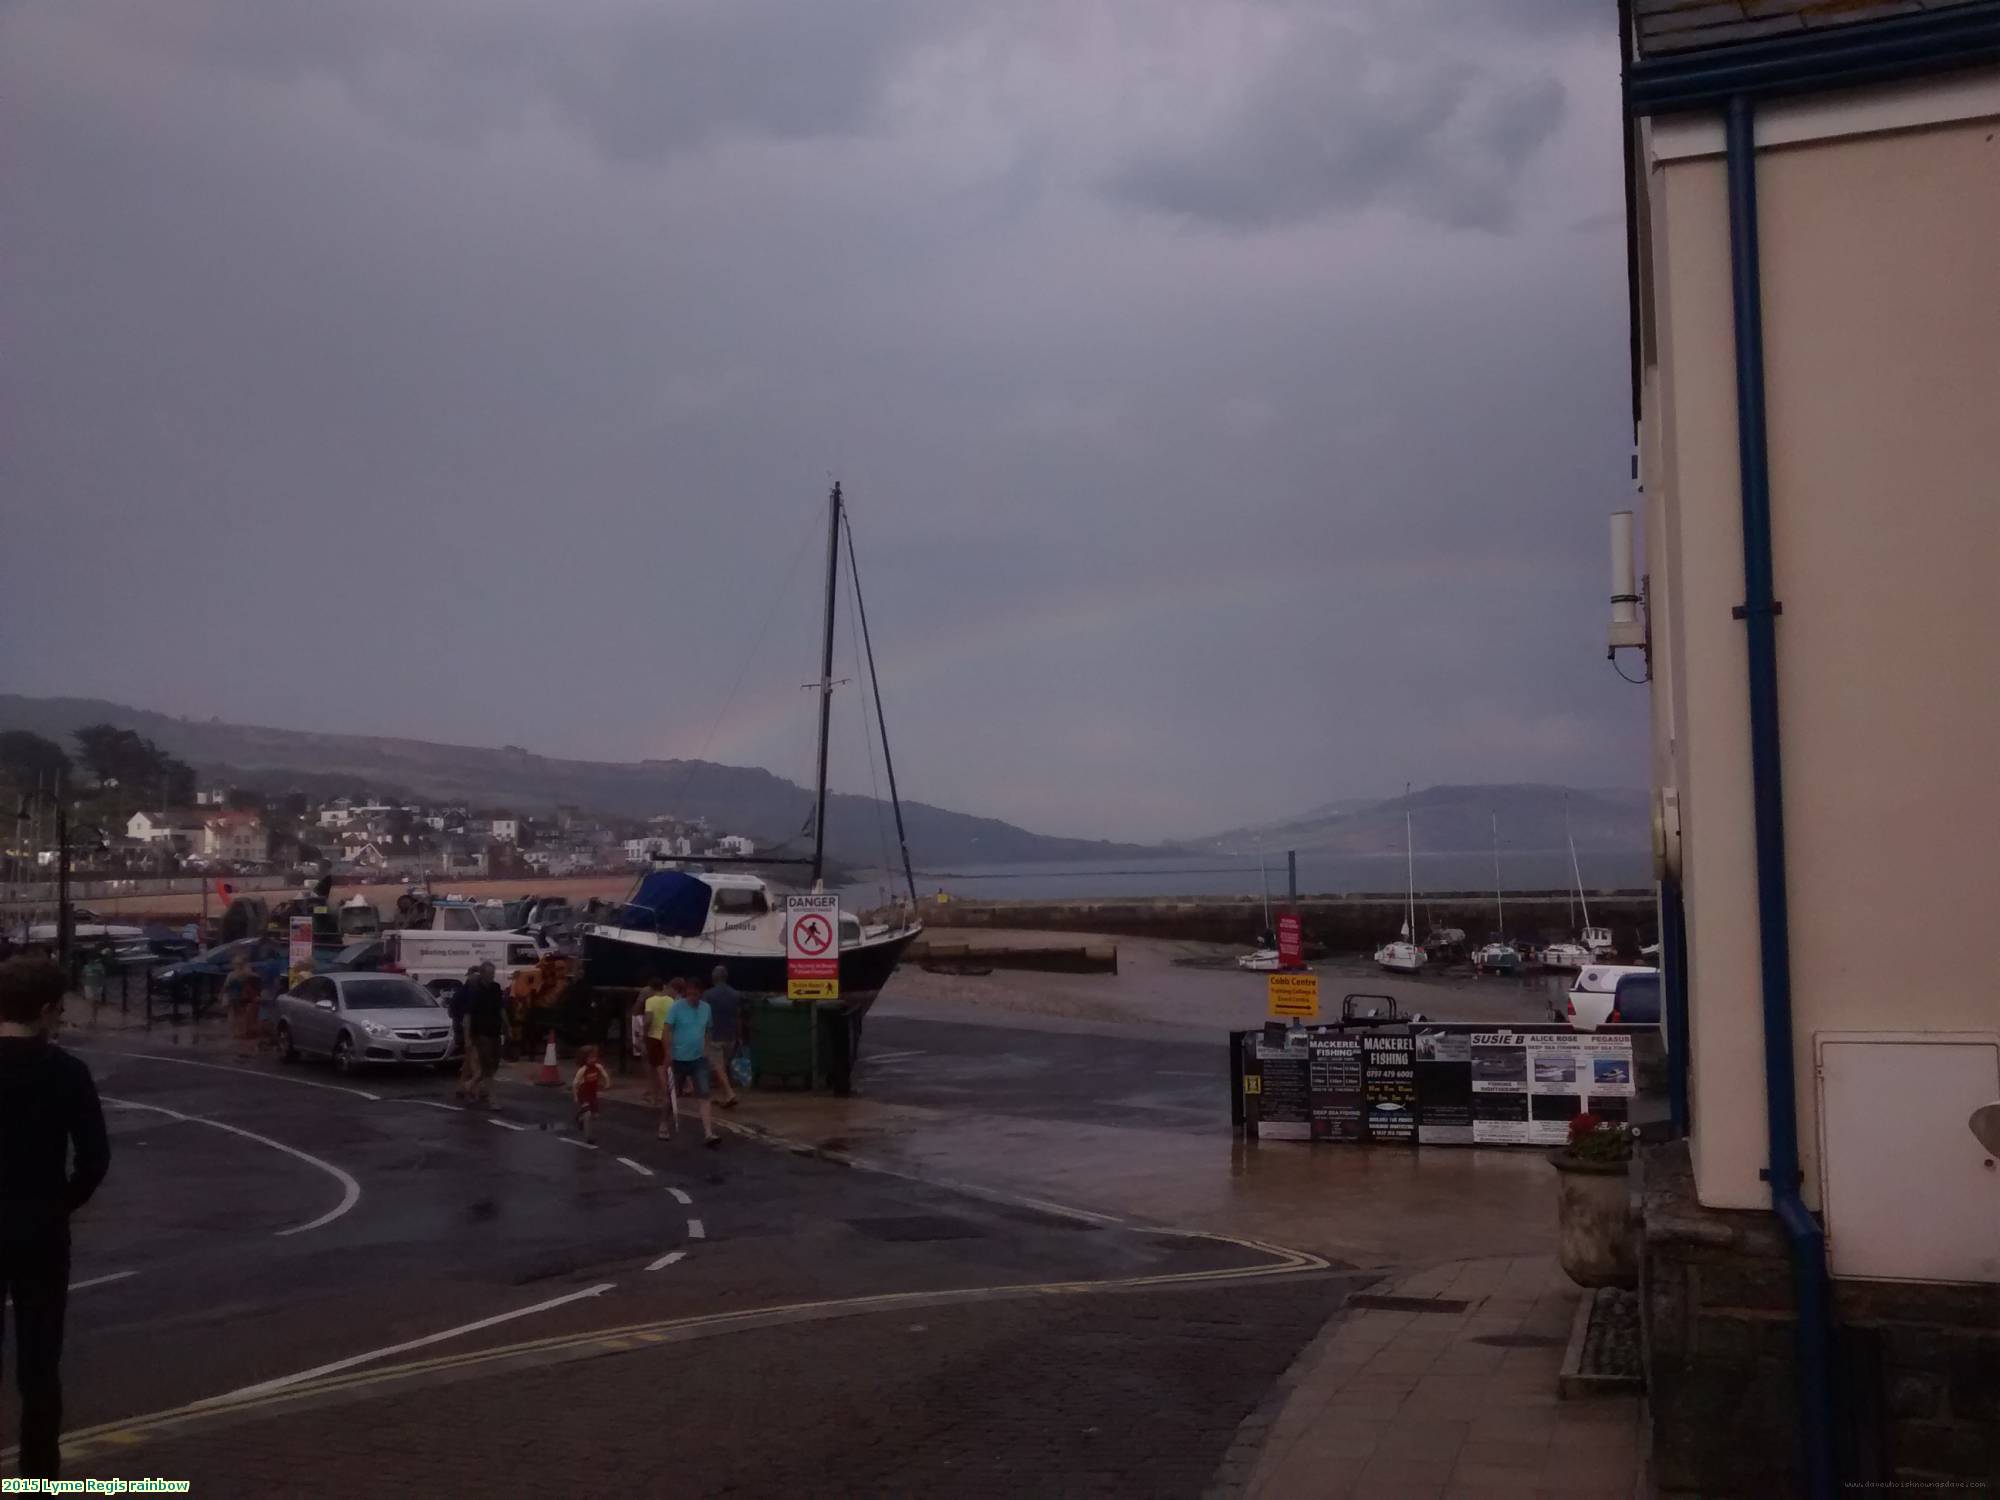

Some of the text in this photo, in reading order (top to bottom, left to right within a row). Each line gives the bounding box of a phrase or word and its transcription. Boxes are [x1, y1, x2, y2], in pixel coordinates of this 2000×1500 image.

[789, 896, 836, 907] DANGER
[1271, 976, 1316, 986] Cobb Centre
[1364, 1038, 1415, 1050] MACKEREL
[1472, 1035, 1525, 1044] SUSIE B
[1370, 1052, 1408, 1065] FISHING
